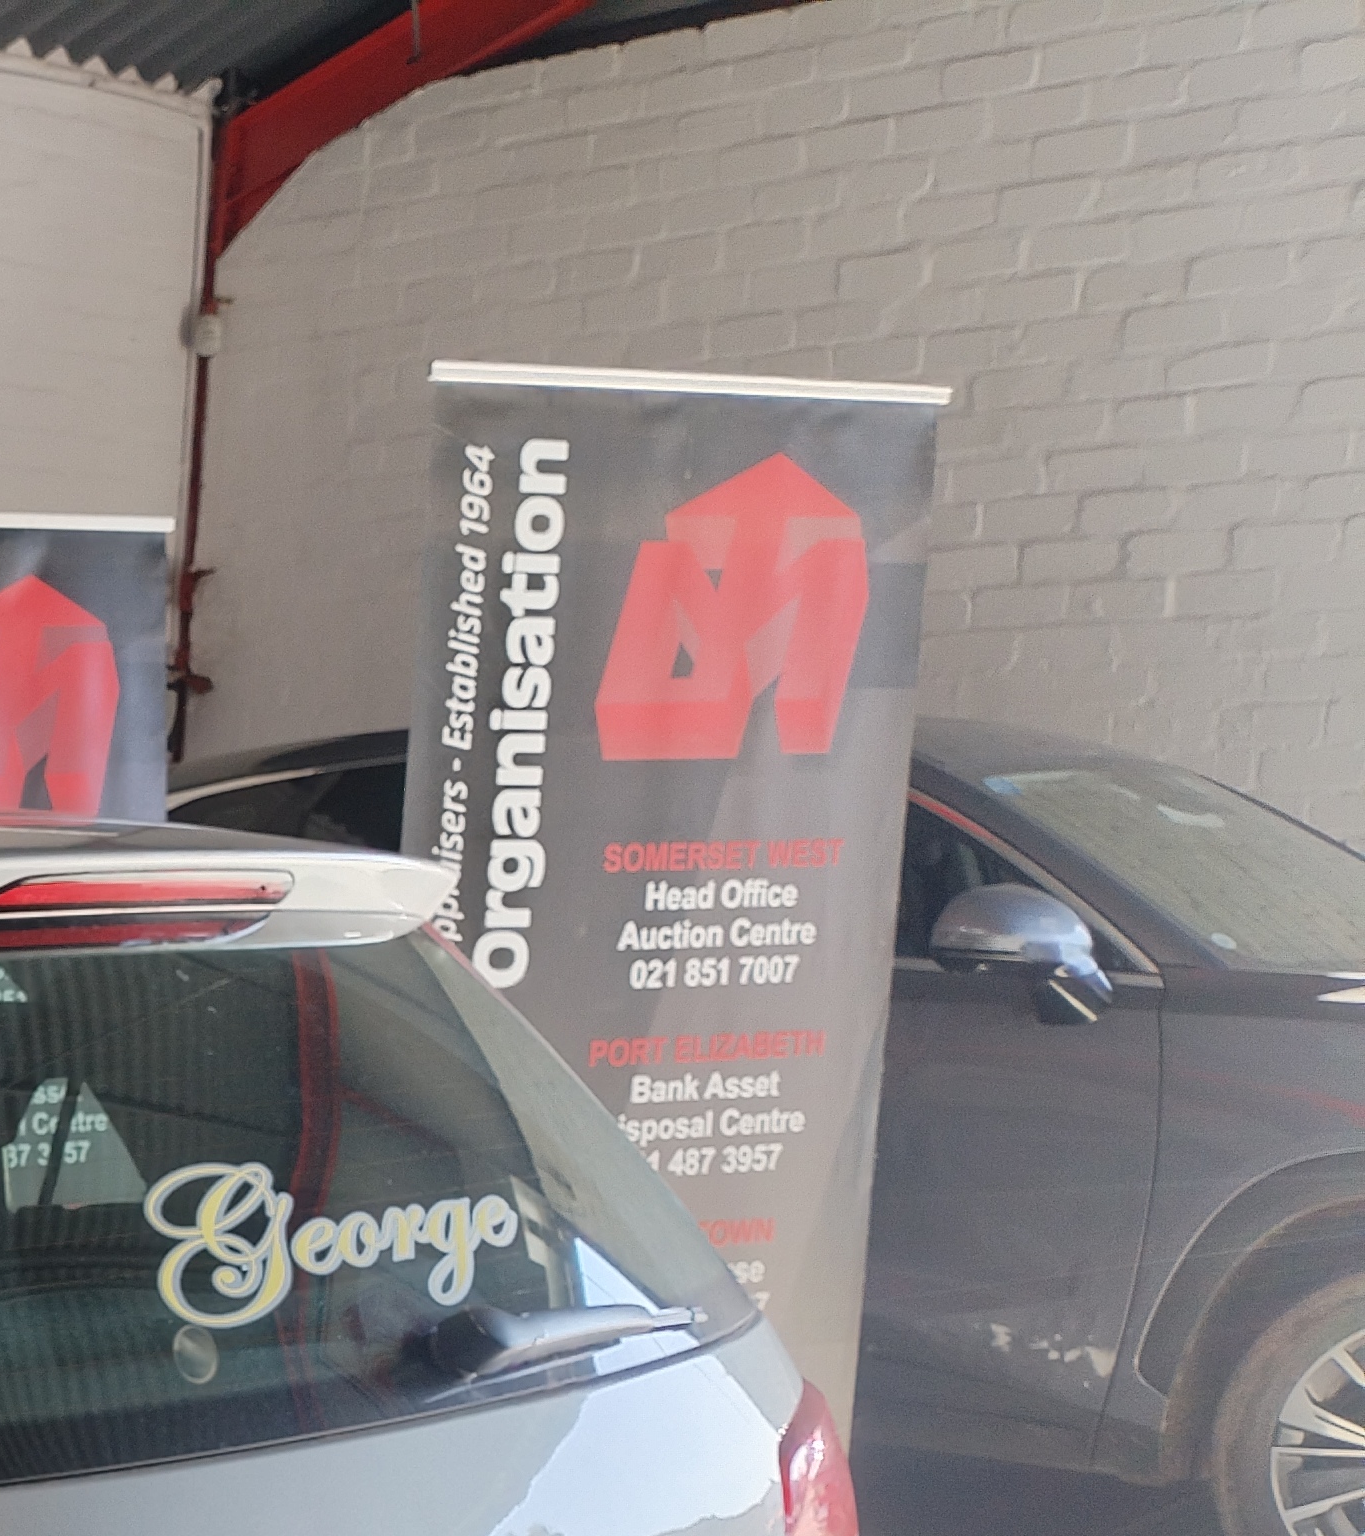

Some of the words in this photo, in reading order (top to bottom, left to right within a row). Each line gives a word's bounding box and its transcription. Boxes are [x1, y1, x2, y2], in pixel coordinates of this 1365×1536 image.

[459, 444, 496, 536] 1964
[442, 543, 488, 751] Established
[472, 438, 570, 989] Organisation
[603, 840, 761, 873] SOMERSET
[768, 838, 845, 869] WEST
[644, 879, 716, 911] Head
[721, 877, 799, 909] Office
[616, 919, 724, 951] Auction
[729, 917, 818, 947] Centre
[629, 957, 677, 990] 021
[684, 956, 730, 987] 851
[738, 954, 800, 985] 7007
[588, 1036, 668, 1067] PORT
[674, 1029, 827, 1063] ELIZABETH
[630, 1072, 700, 1104] Bank
[703, 1069, 781, 1100] Asset
[617, 1109, 715, 1147] isposal
[719, 1107, 807, 1137] Centre
[668, 1146, 717, 1177] 487
[721, 1142, 784, 1174] 3957
[144, 1161, 519, 1329] George
